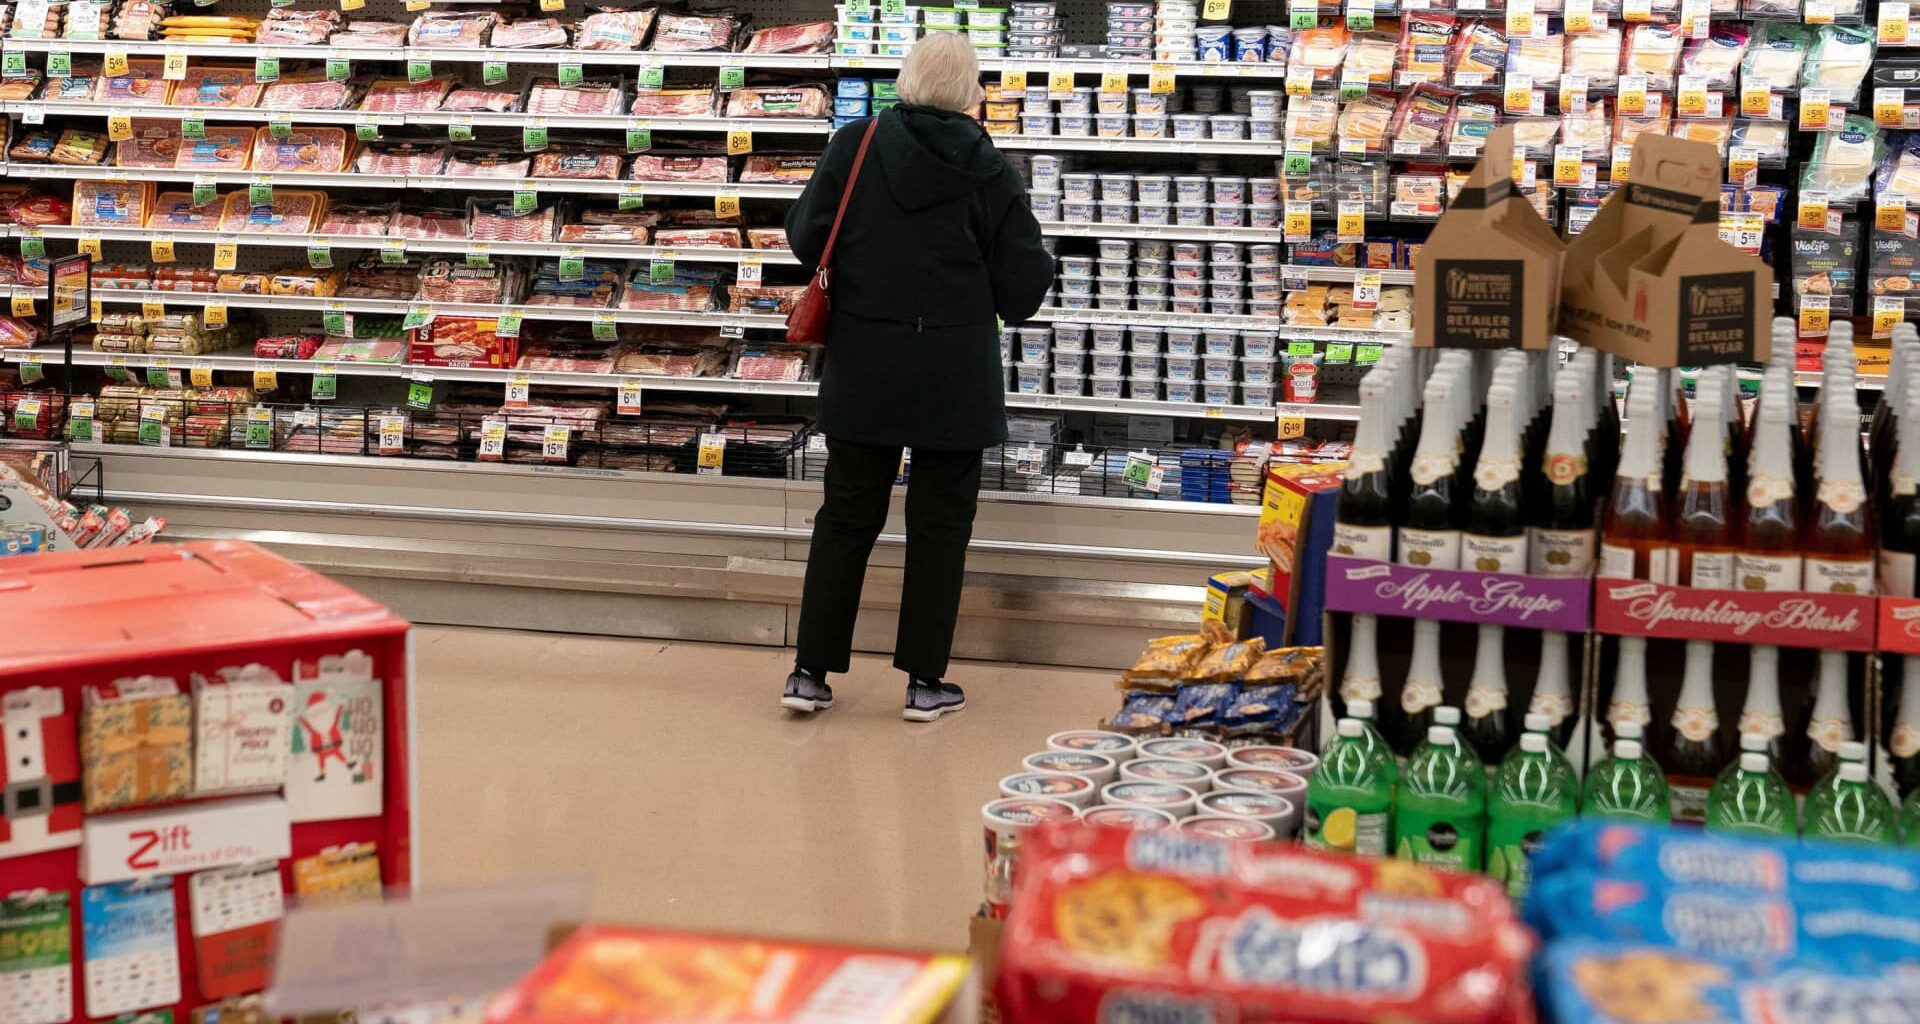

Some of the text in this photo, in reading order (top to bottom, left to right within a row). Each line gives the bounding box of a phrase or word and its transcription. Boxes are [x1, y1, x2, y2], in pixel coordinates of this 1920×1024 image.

[109, 58, 124, 70] 549
[112, 122, 127, 134] 399
[732, 136, 747, 148] 899
[720, 201, 735, 212] 899
[1741, 233, 1756, 245] 599
[1795, 240, 1830, 255] Violife
[1360, 287, 1374, 300] 599
[1447, 315, 1510, 326] RETAILER
[1475, 328, 1510, 339] YEAR
[1688, 329, 1744, 341] RETAILER
[1713, 342, 1744, 354] YEAR
[1283, 423, 1300, 434] 649
[383, 434, 400, 446] 1599
[1375, 572, 1565, 621] Apple-Grape
[1624, 590, 1861, 636] Sparkling Blush
[127, 824, 191, 870] Zift
[1419, 852, 1463, 864] LEMON
